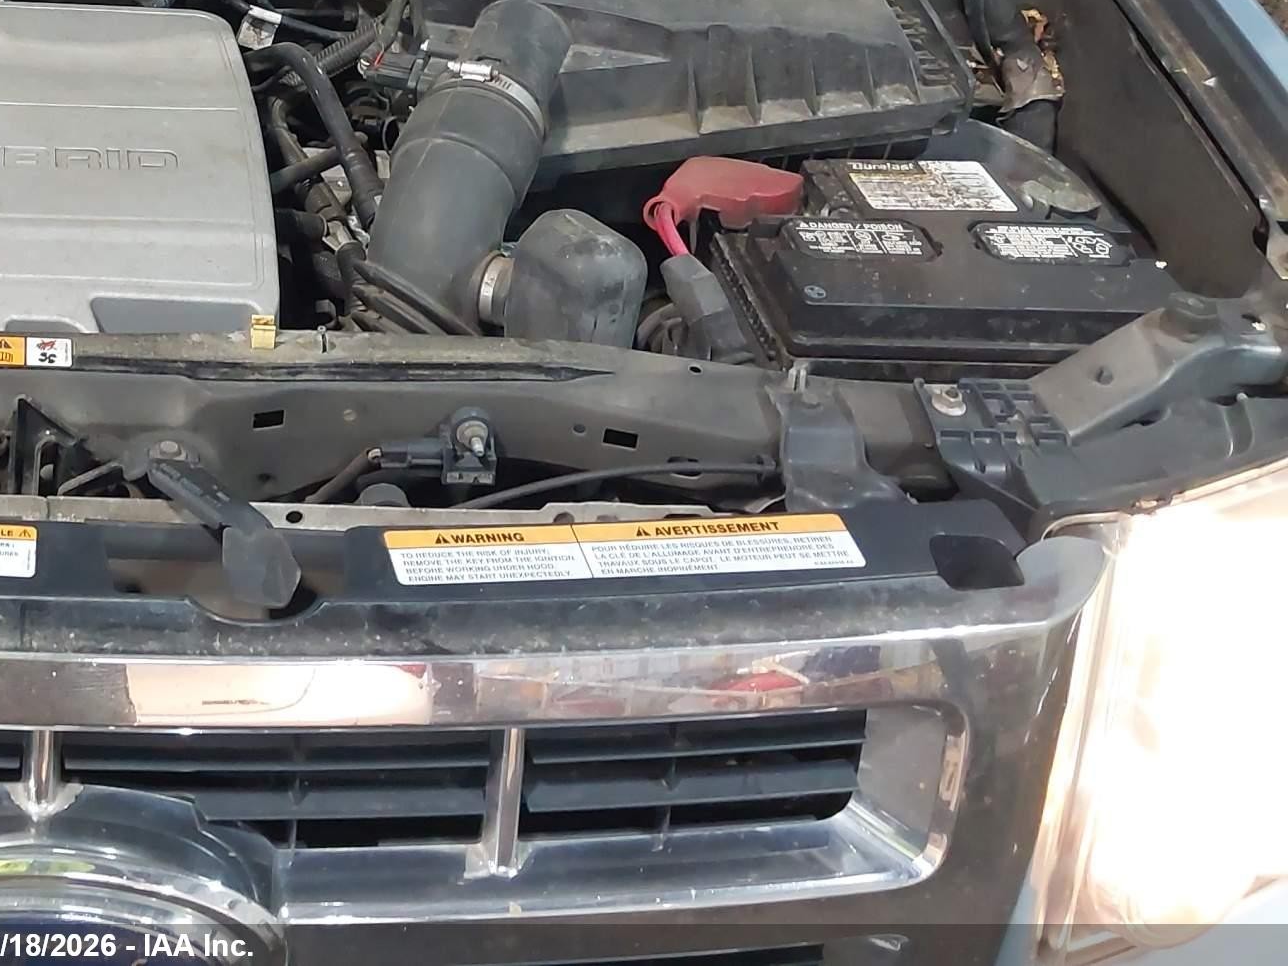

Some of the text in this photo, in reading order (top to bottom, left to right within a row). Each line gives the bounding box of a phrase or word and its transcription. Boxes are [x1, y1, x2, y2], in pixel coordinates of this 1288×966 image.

[809, 221, 853, 230] DANGER
[863, 223, 903, 232] POISON
[652, 521, 782, 535] AVERTISSEMENT
[450, 532, 524, 543] WARNING
